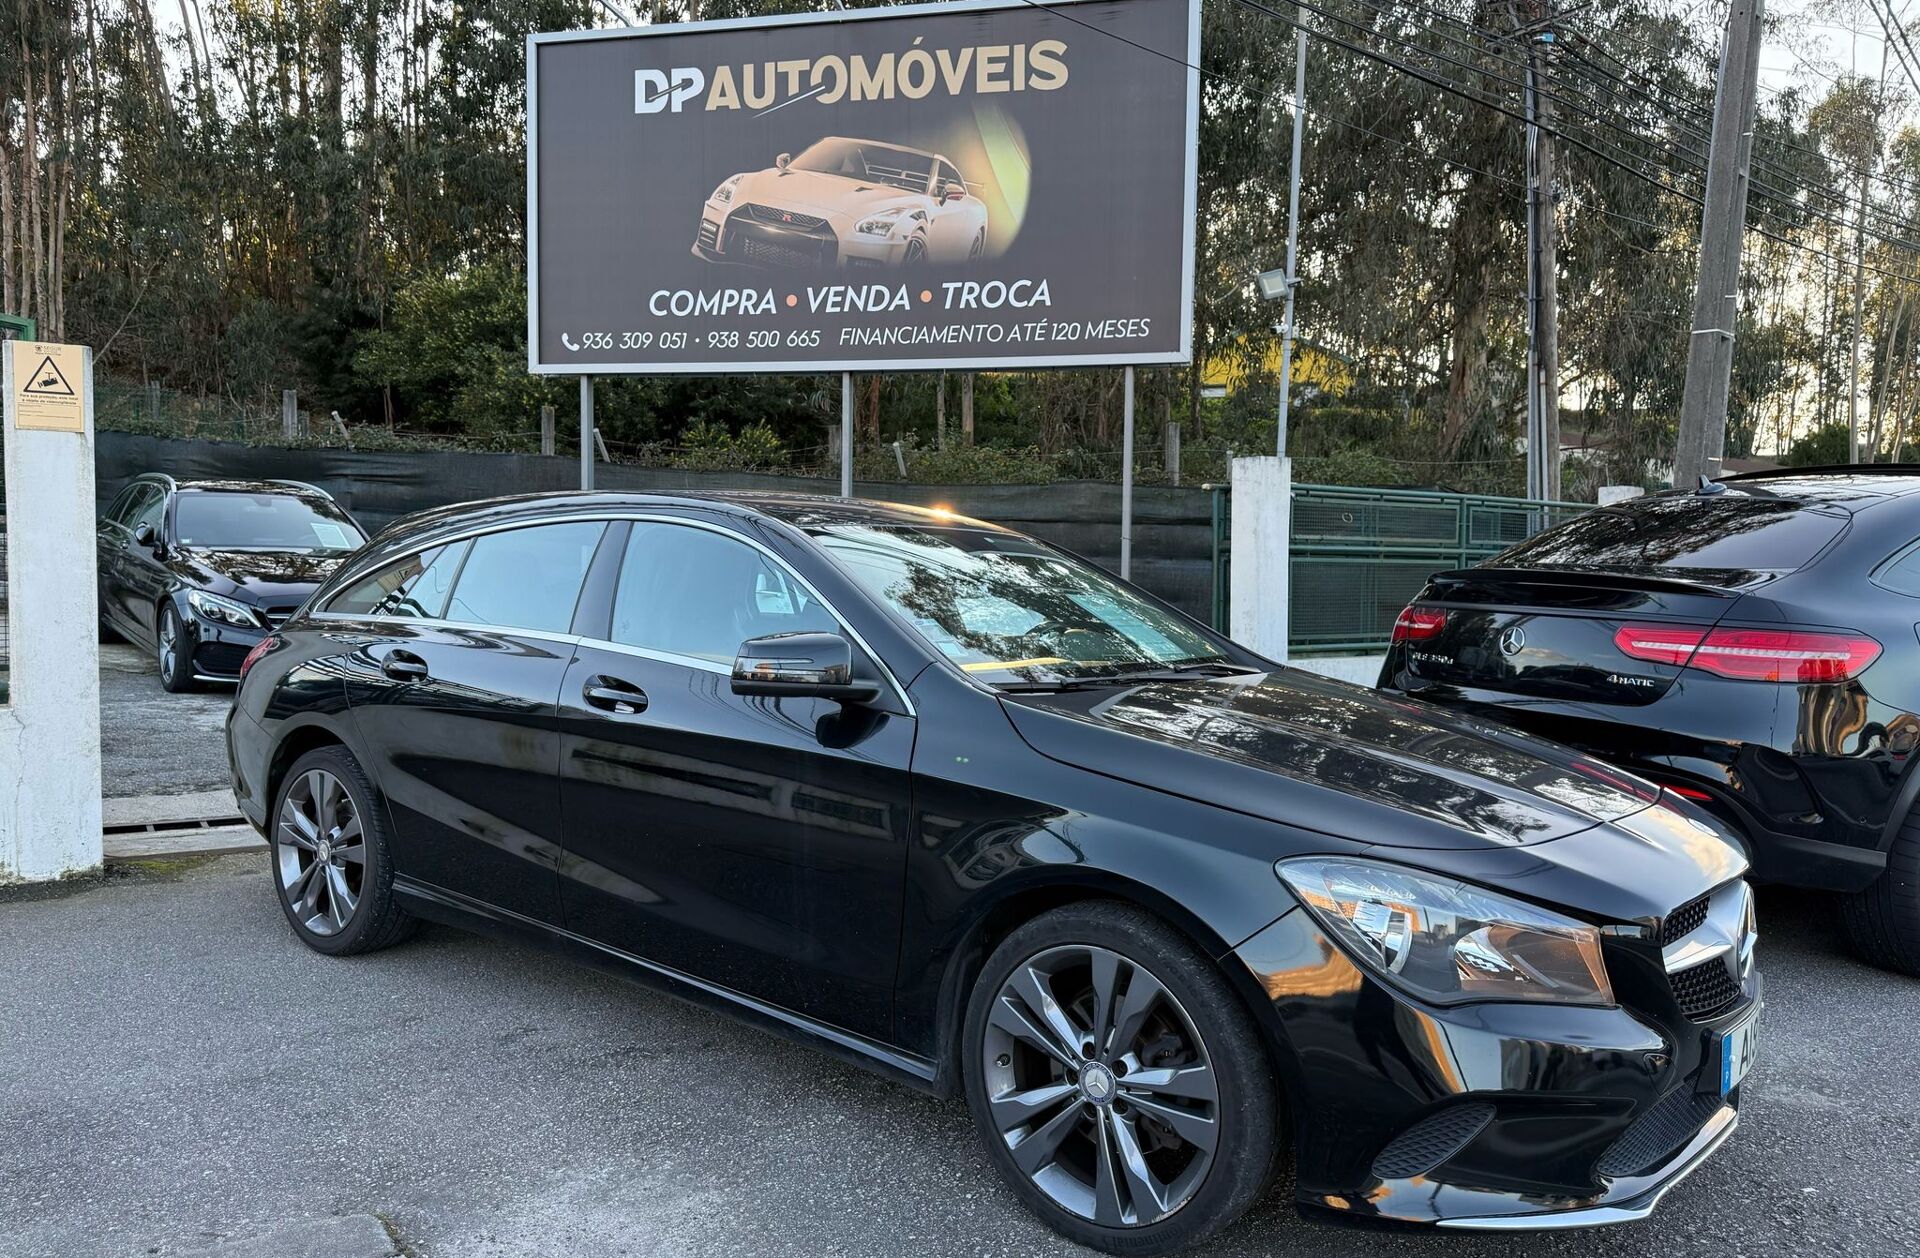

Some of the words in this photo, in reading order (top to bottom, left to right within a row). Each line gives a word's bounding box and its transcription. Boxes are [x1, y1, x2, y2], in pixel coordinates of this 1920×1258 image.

[649, 288, 777, 317] COMPRA
[806, 284, 911, 313] VENDA
[941, 279, 1053, 310] TROCA
[582, 332, 613, 349] 936
[619, 332, 653, 349] 309
[659, 332, 688, 349] 051
[708, 331, 739, 348] 938
[746, 331, 780, 348] 500
[787, 330, 821, 347] 665
[839, 324, 1004, 346] FINANCIAMENTO
[1006, 318, 1048, 342] ATÉ
[1051, 322, 1081, 341] 120
[1084, 318, 1151, 340] MESES
